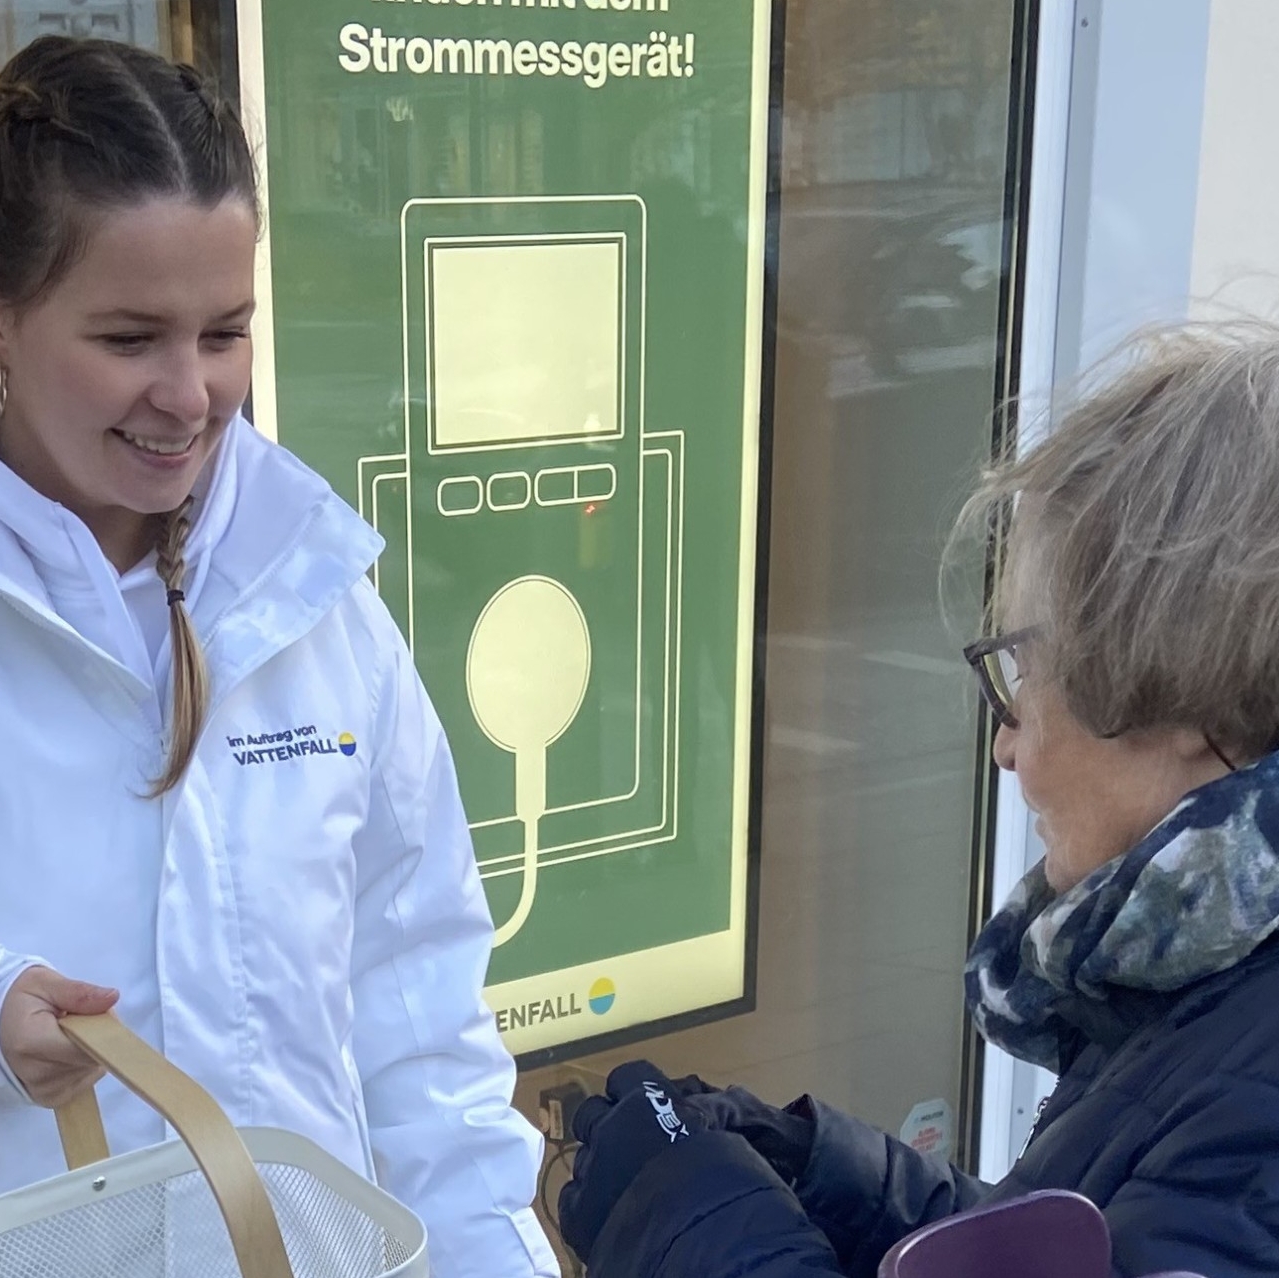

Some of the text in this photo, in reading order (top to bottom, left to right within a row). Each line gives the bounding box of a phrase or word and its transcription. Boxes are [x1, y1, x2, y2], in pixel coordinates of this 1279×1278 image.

[339, 23, 695, 89] Strommessgerät!
[247, 729, 293, 746] Auftrag
[294, 725, 317, 736] von
[233, 739, 338, 766] VATTENFALL
